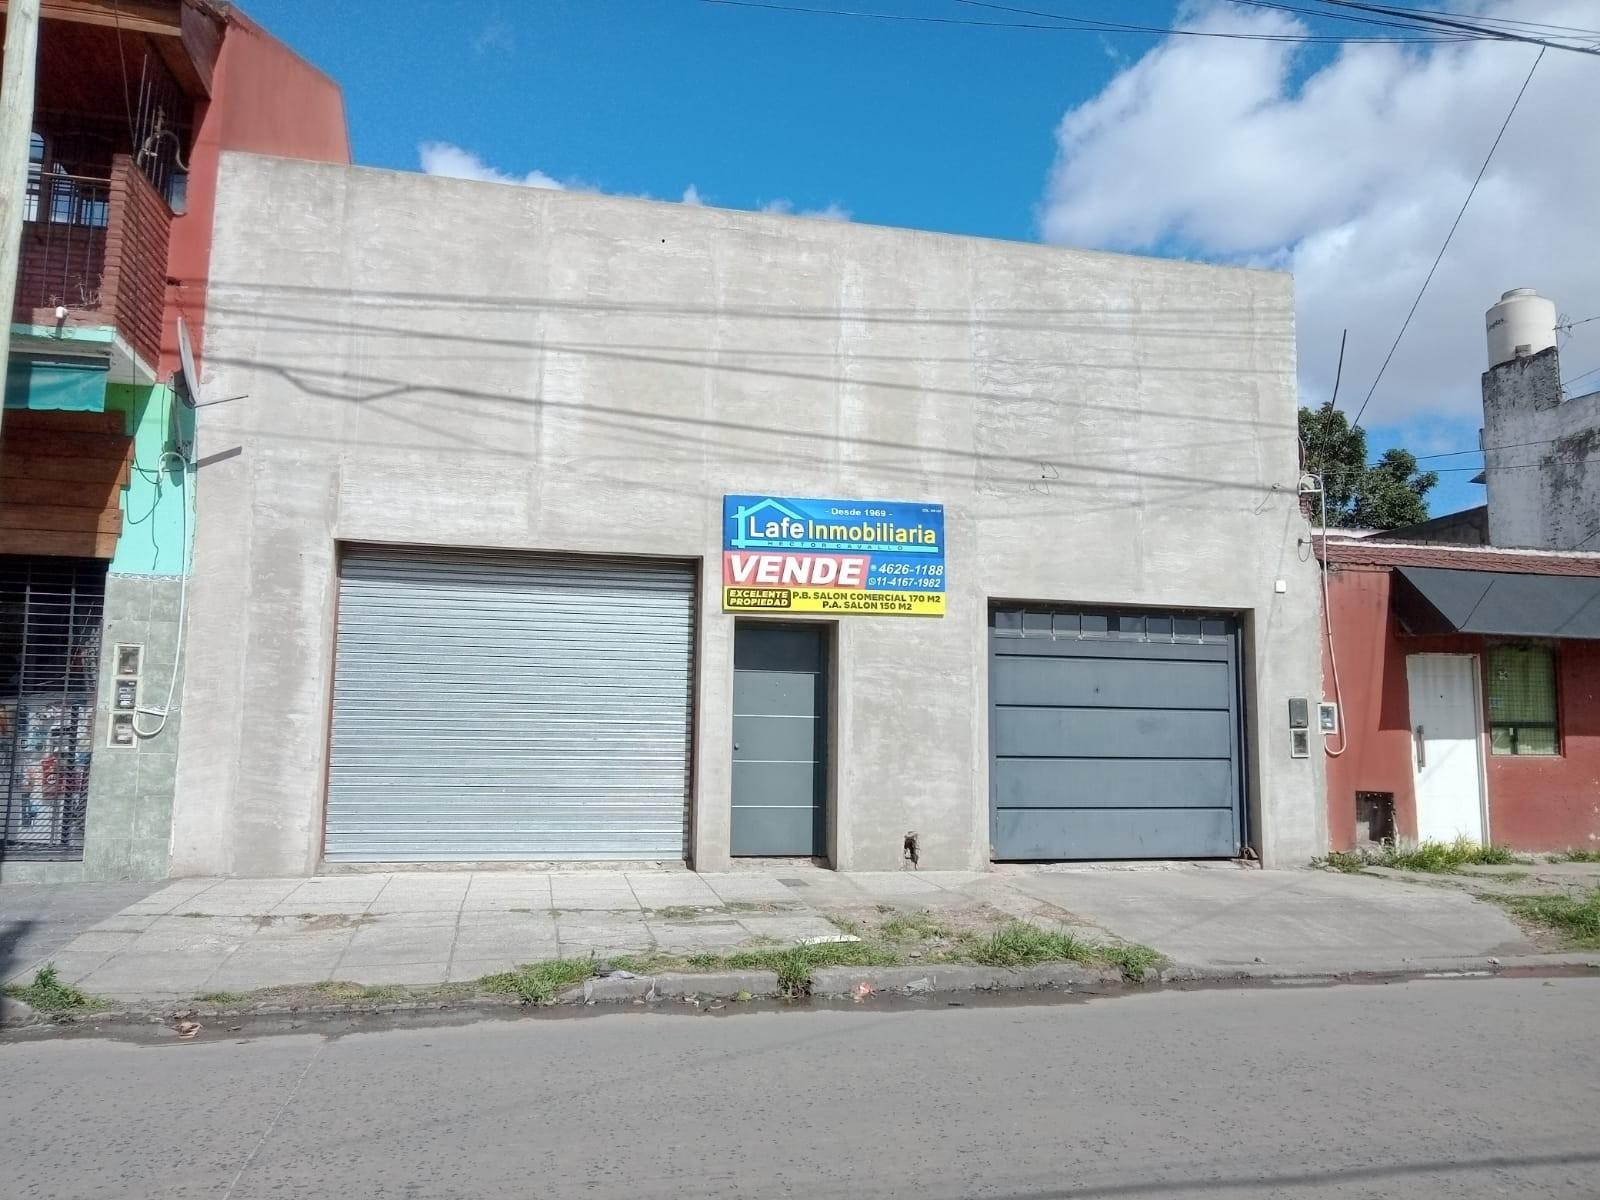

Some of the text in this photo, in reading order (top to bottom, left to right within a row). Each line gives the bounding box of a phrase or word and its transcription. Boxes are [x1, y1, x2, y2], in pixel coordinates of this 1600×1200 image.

[831, 508, 861, 516] Desde
[750, 516, 935, 544] Lafe Inmobiliaria
[730, 555, 864, 585] VENDE
[879, 564, 943, 575] 4626-1188
[876, 578, 940, 588] 11-4167-1982
[729, 590, 788, 599] EXCELENTE
[729, 598, 788, 607] PROPIEDAD
